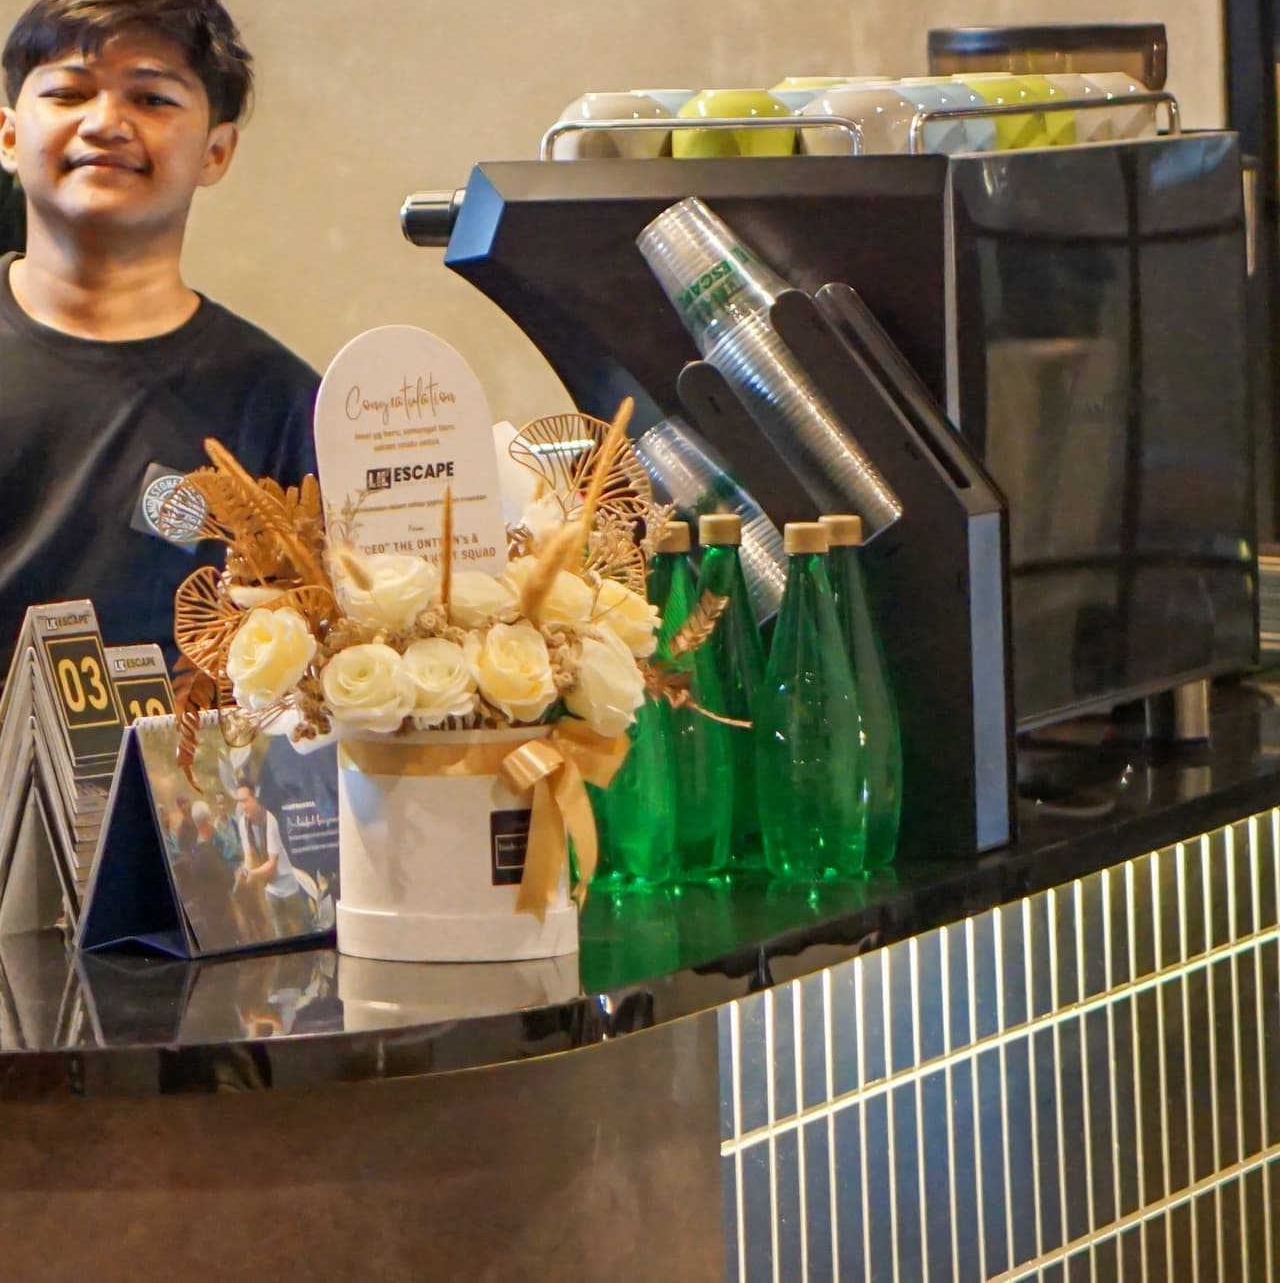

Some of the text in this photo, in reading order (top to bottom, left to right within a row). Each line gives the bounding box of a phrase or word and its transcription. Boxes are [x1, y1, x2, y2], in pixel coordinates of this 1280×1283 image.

[393, 462, 454, 483] ESCAPE
[394, 540, 413, 553] THE
[461, 547, 496, 561] SQUAD
[57, 656, 108, 713] 03
